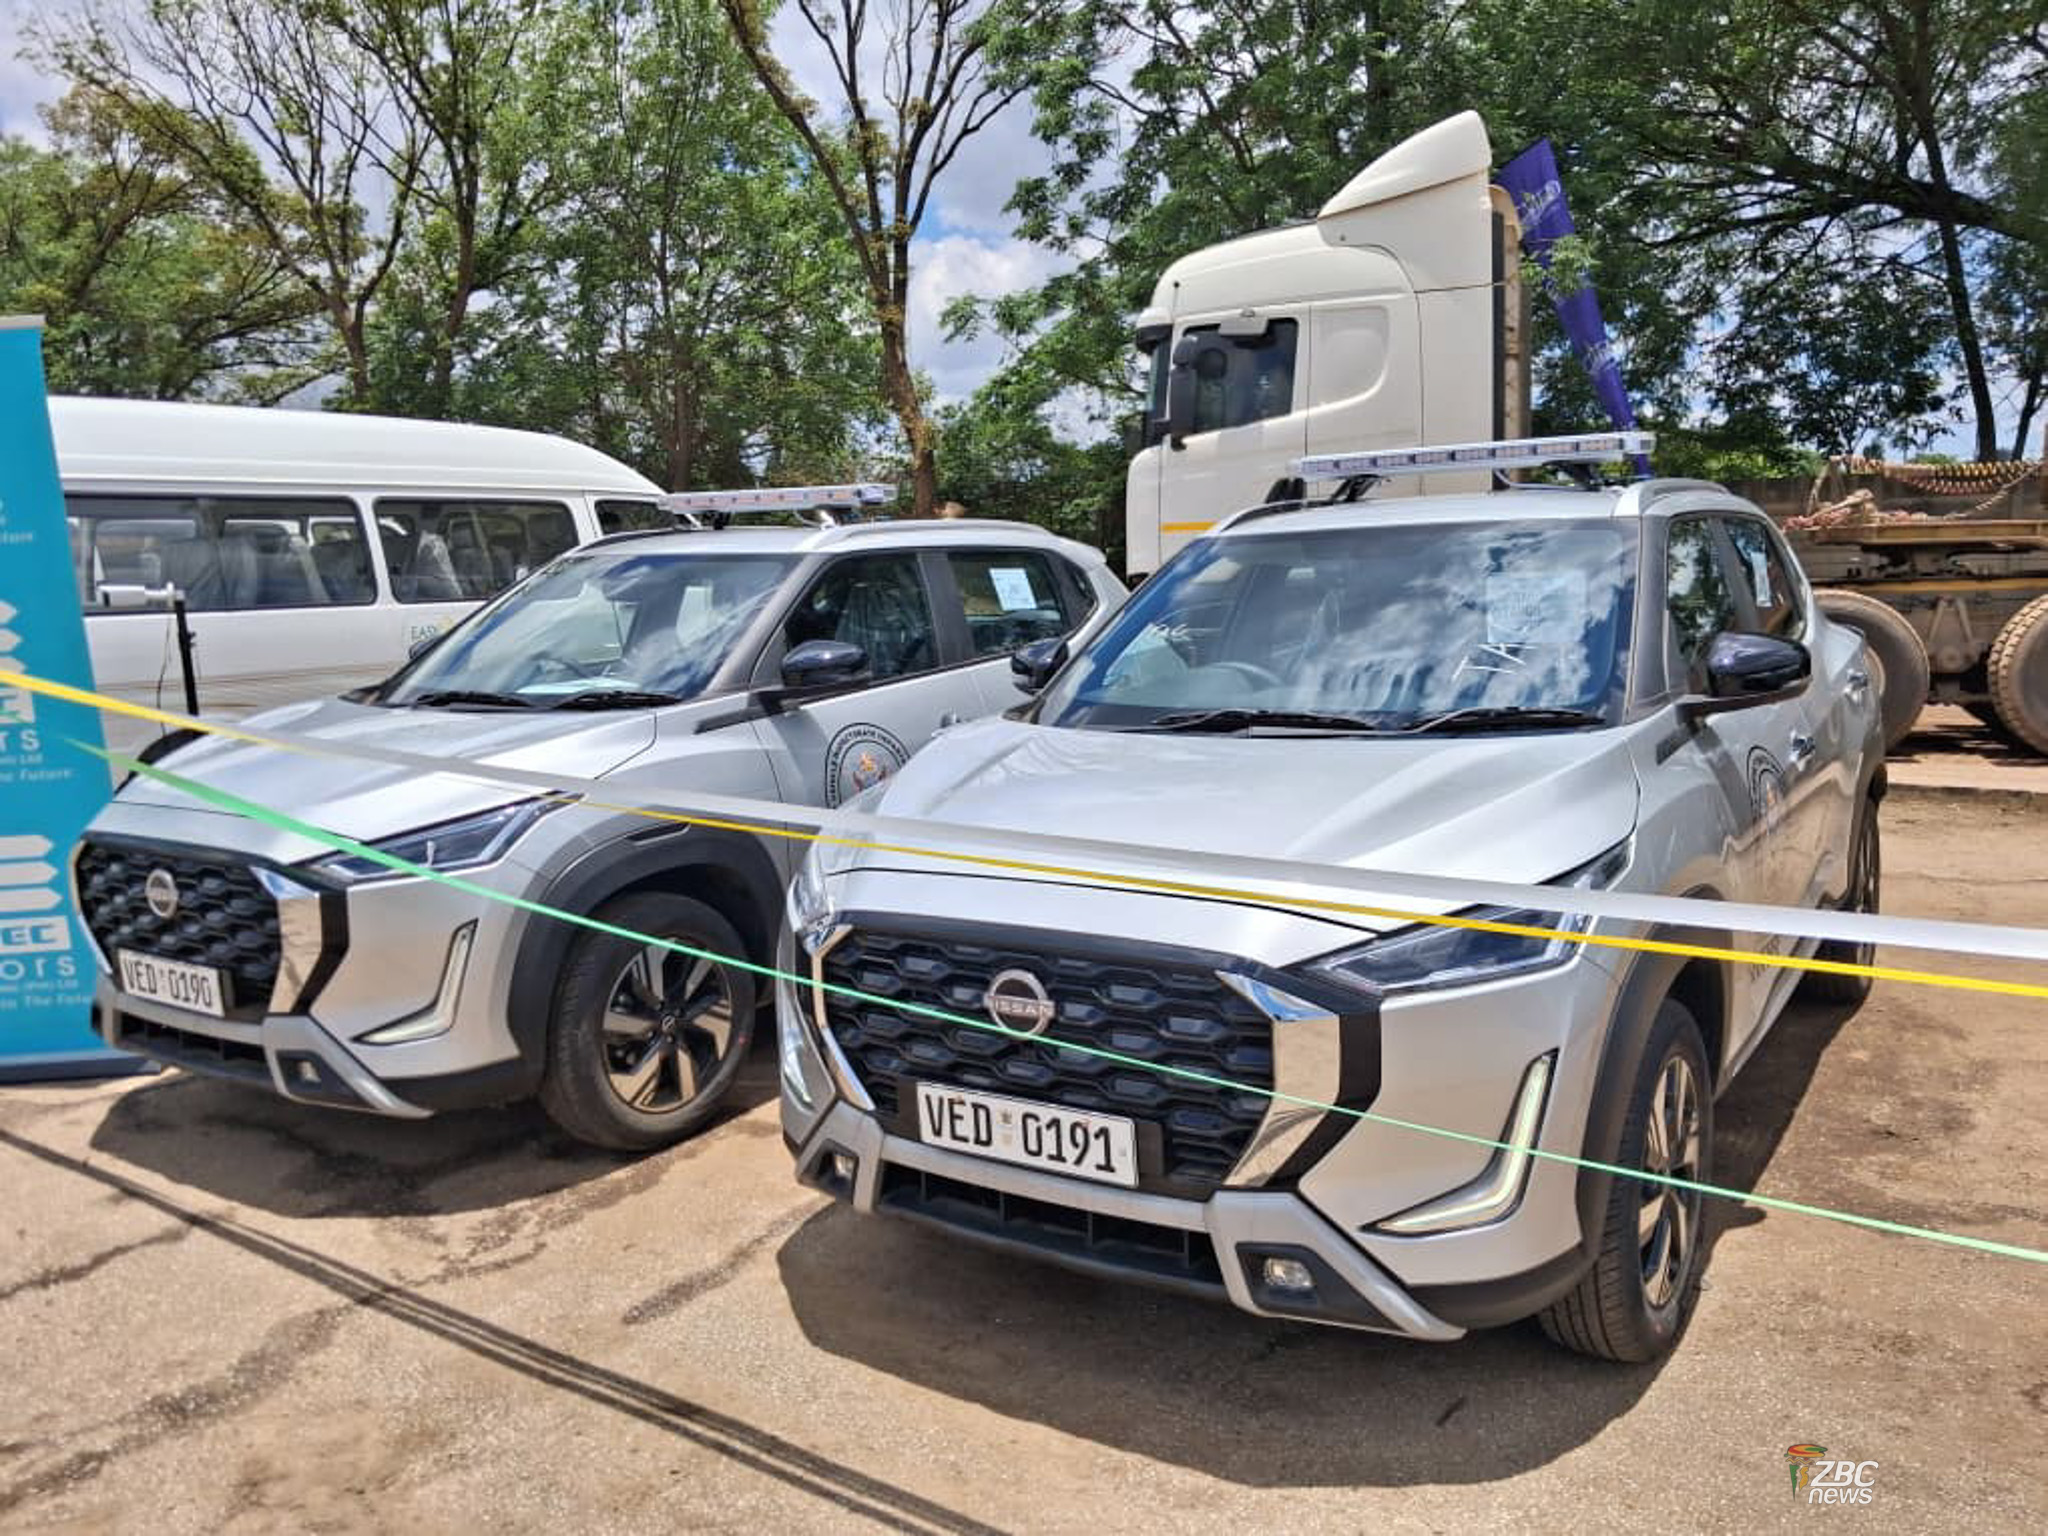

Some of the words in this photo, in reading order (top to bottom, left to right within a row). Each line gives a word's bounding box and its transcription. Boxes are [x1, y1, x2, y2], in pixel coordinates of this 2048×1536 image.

[124, 957, 157, 995] VED
[168, 968, 212, 1008] 0190
[925, 1094, 993, 1147] VED
[1021, 1111, 1116, 1173] 0191
